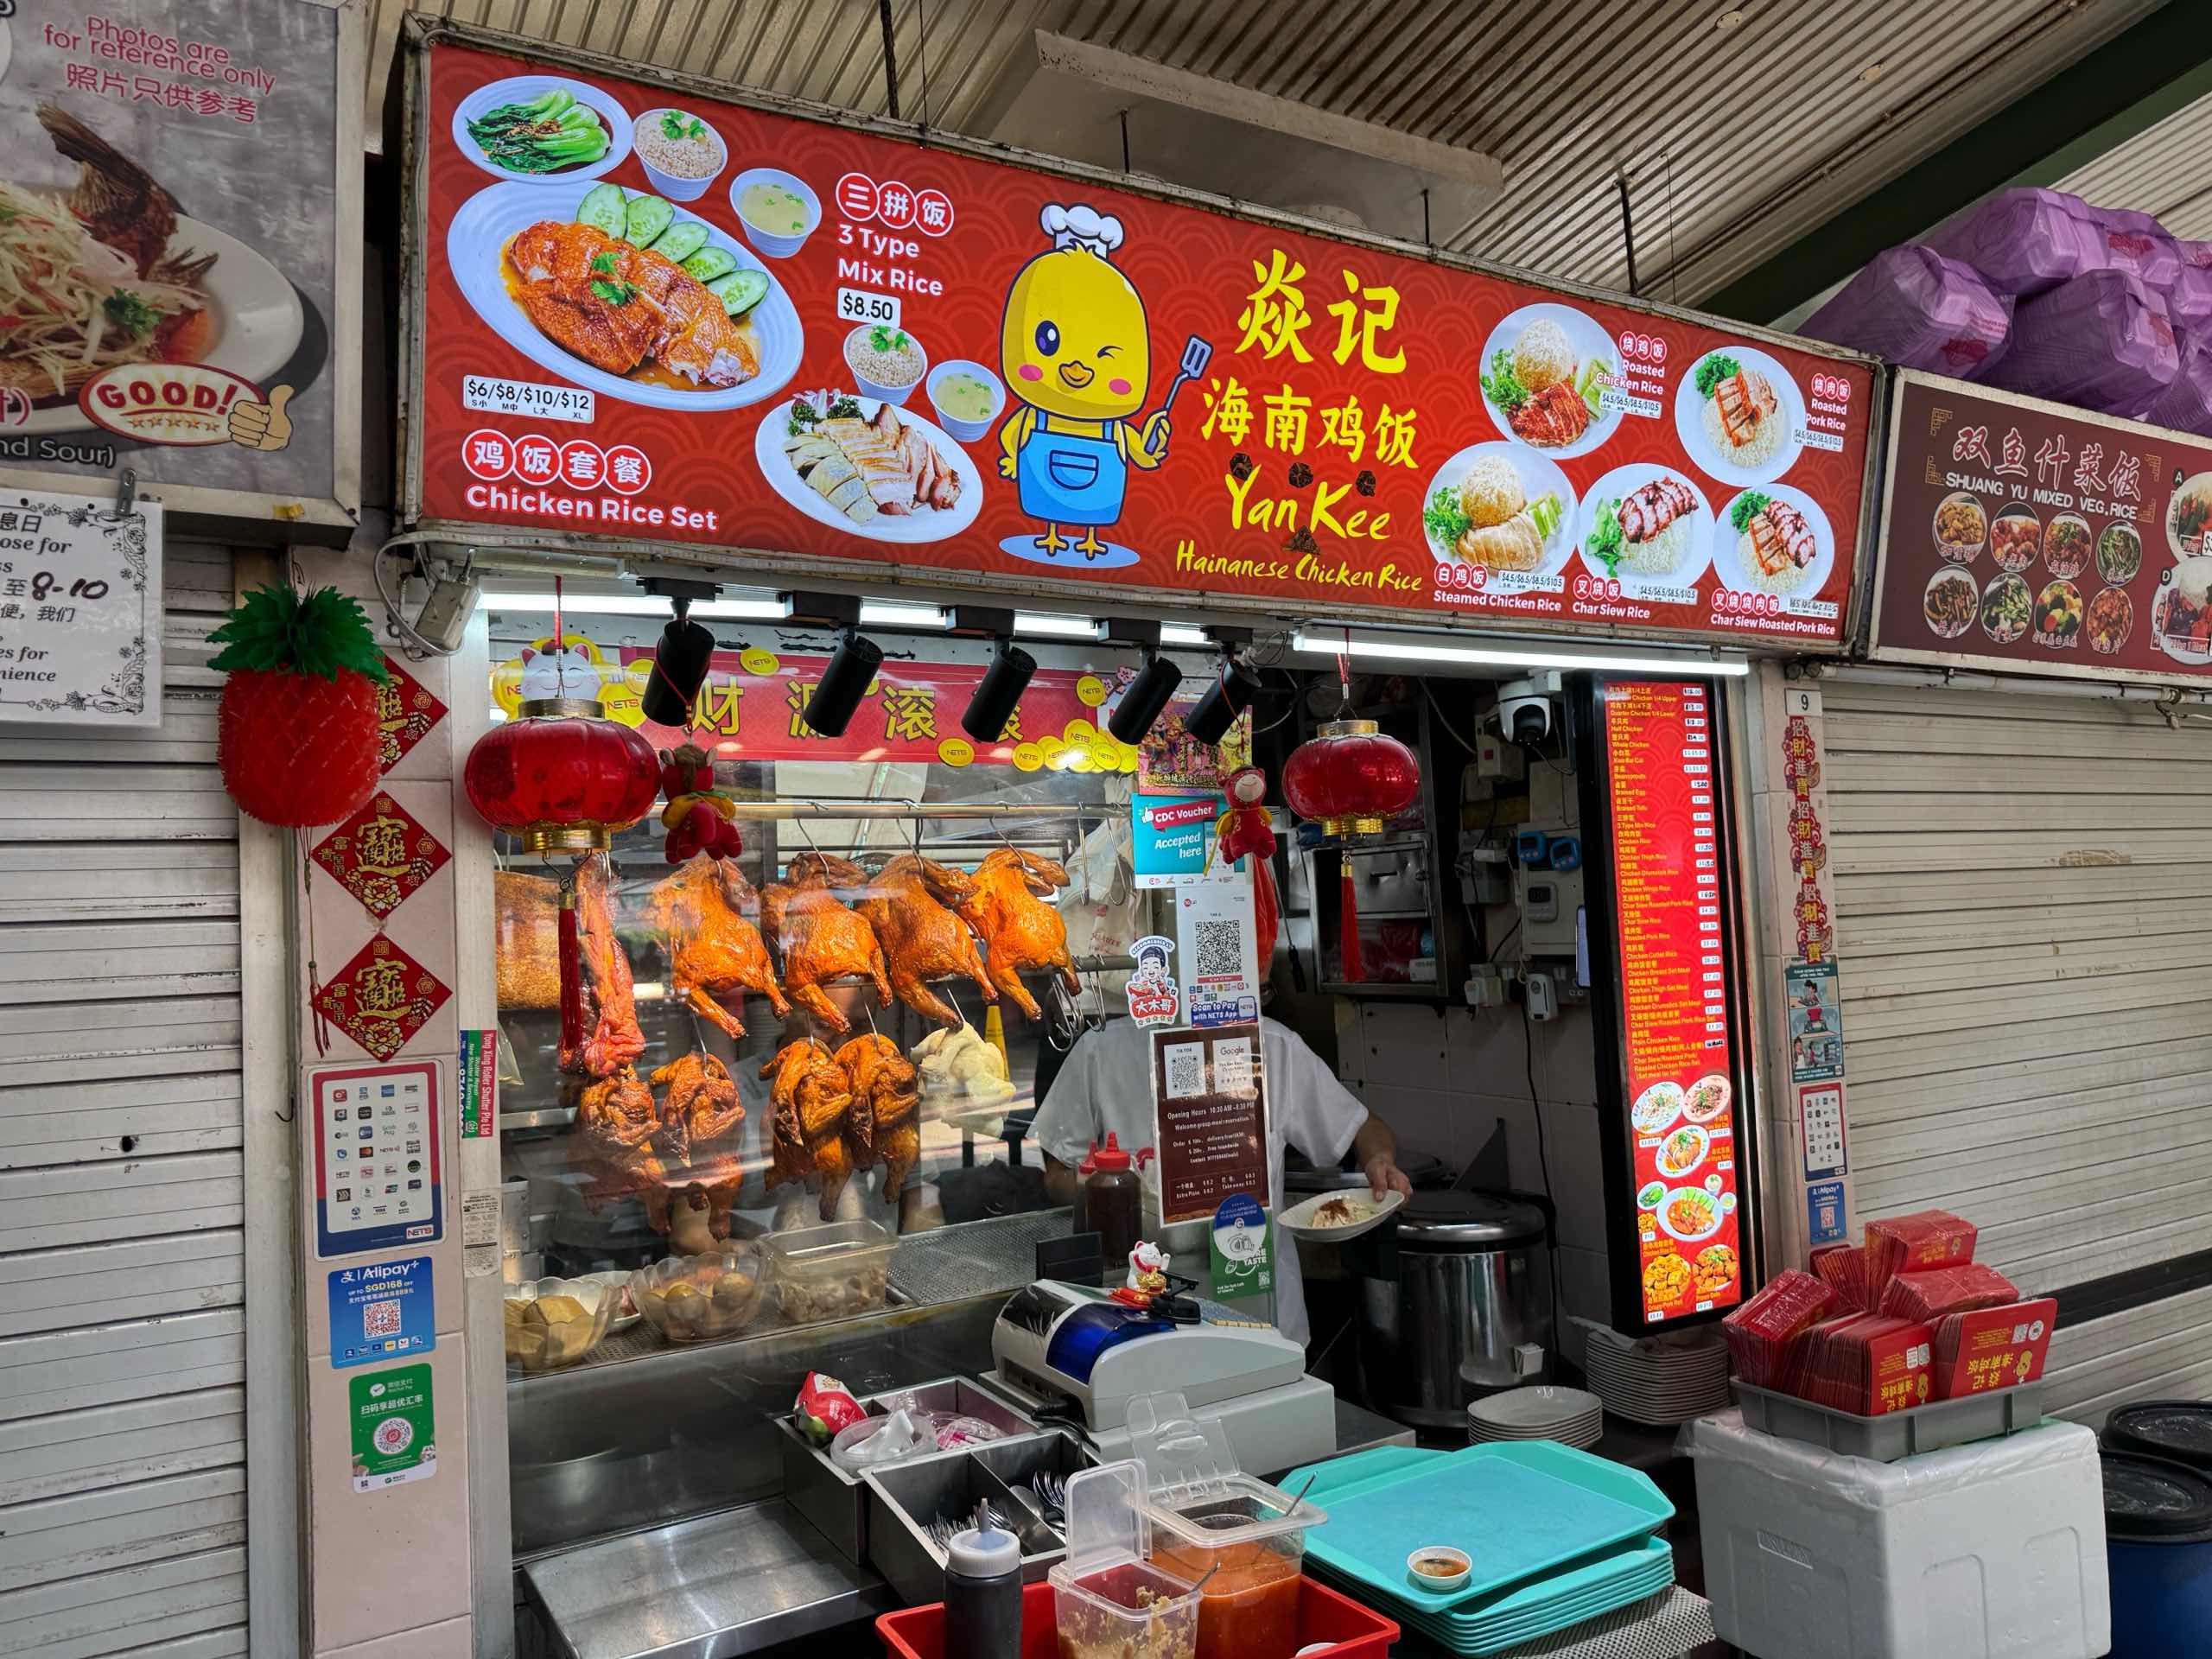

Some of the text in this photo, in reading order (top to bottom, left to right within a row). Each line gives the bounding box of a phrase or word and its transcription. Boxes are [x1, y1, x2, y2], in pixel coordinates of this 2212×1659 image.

[86, 16, 230, 65] Photos are
[43, 23, 276, 95] for reference only
[66, 61, 258, 124] 照片只供参考
[846, 183, 947, 228] 三拼饭
[837, 223, 920, 258] 3 Type
[837, 257, 944, 296] Mix Rice
[842, 291, 894, 321] $8.50
[1234, 248, 1408, 374] 焱记
[1622, 359, 1665, 378] Roasted
[1596, 372, 1664, 395] Chicken Rice
[96, 378, 238, 416] GOOD!
[467, 378, 590, 410] $6/$8/$10/$12
[573, 410, 583, 420] XL
[1811, 397, 1847, 415] Roasted
[1201, 376, 1420, 470] 海南鸡饭
[1805, 413, 1847, 431] Pork Rice
[40, 440, 115, 467] Sour)
[474, 440, 642, 486] 鸡饭套餐
[1945, 471, 2005, 496] SHUANG
[2010, 483, 2029, 501] YU
[2032, 488, 2074, 509] MIXED
[466, 485, 719, 531] Chicken Rice Set
[1224, 463, 1391, 541] Yan Kee
[36, 537, 73, 556] for
[1175, 539, 1424, 592] Hainanese Chicken Rice
[32, 570, 110, 601] 8-10
[1436, 566, 1485, 587] 白鸡饭
[2, 577, 28, 597] 至
[1433, 589, 1562, 613] Steamed Chicken Rice
[1572, 601, 1651, 619] Char Siew Rice
[1710, 613, 1836, 636] Char Siew Roasted Pork Rice
[16, 645, 49, 663] for
[606, 699, 639, 710] NETS
[1800, 693, 1809, 711] 9
[1071, 732, 1091, 744] NETS
[1154, 805, 1213, 823] CDC Voucher
[1154, 832, 1202, 850] Accepted
[1179, 847, 1203, 860] here
[1136, 998, 1173, 1015] 大木哥
[1192, 1001, 1236, 1012] Scan to Pay
[1193, 1010, 1237, 1021] with NETS App
[482, 1033, 494, 1049] Yong
[1220, 1045, 1244, 1057] Google
[481, 1050, 493, 1065] Xing
[1167, 1110, 1190, 1121] Opening
[1191, 1109, 1207, 1119] Hours
[1210, 1105, 1224, 1115] 10:30
[1174, 1122, 1197, 1131] Welcome
[407, 1227, 432, 1236] NETS
